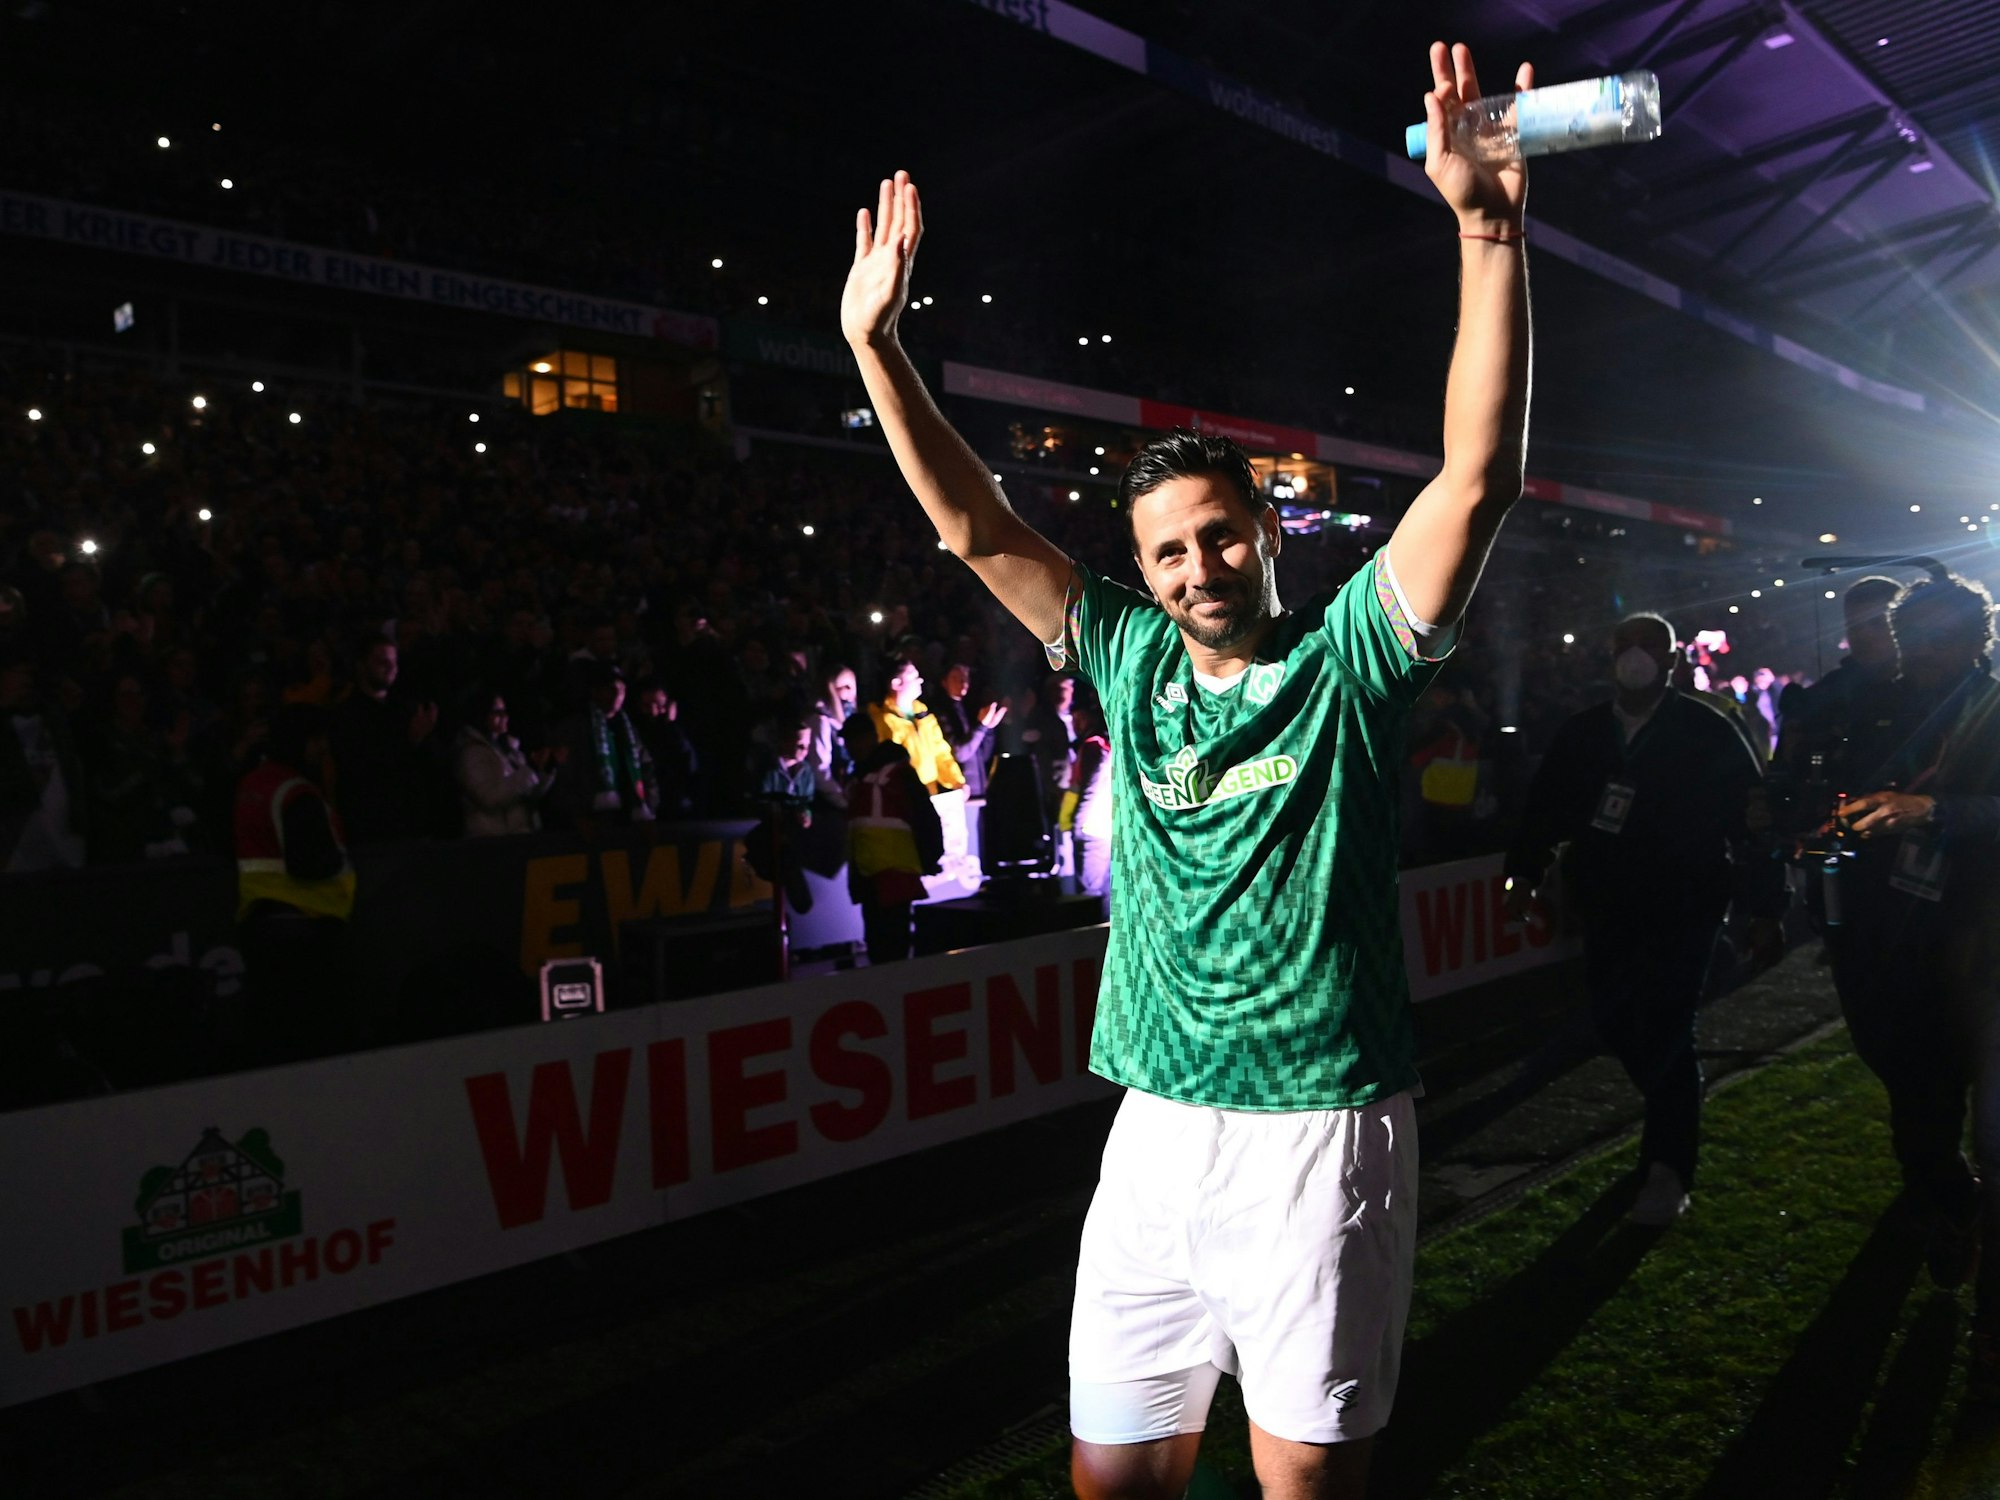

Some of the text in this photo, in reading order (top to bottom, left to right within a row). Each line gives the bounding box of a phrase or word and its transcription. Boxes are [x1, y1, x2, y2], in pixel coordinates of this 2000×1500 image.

[63, 208, 201, 259] KRIEGT
[212, 236, 312, 276] JEDER
[324, 256, 421, 295] EINEN
[432, 274, 643, 332] EINGESCHENKT
[13, 1218, 396, 1353] WIESENHOF
[157, 1221, 271, 1261] ORIGINAL
